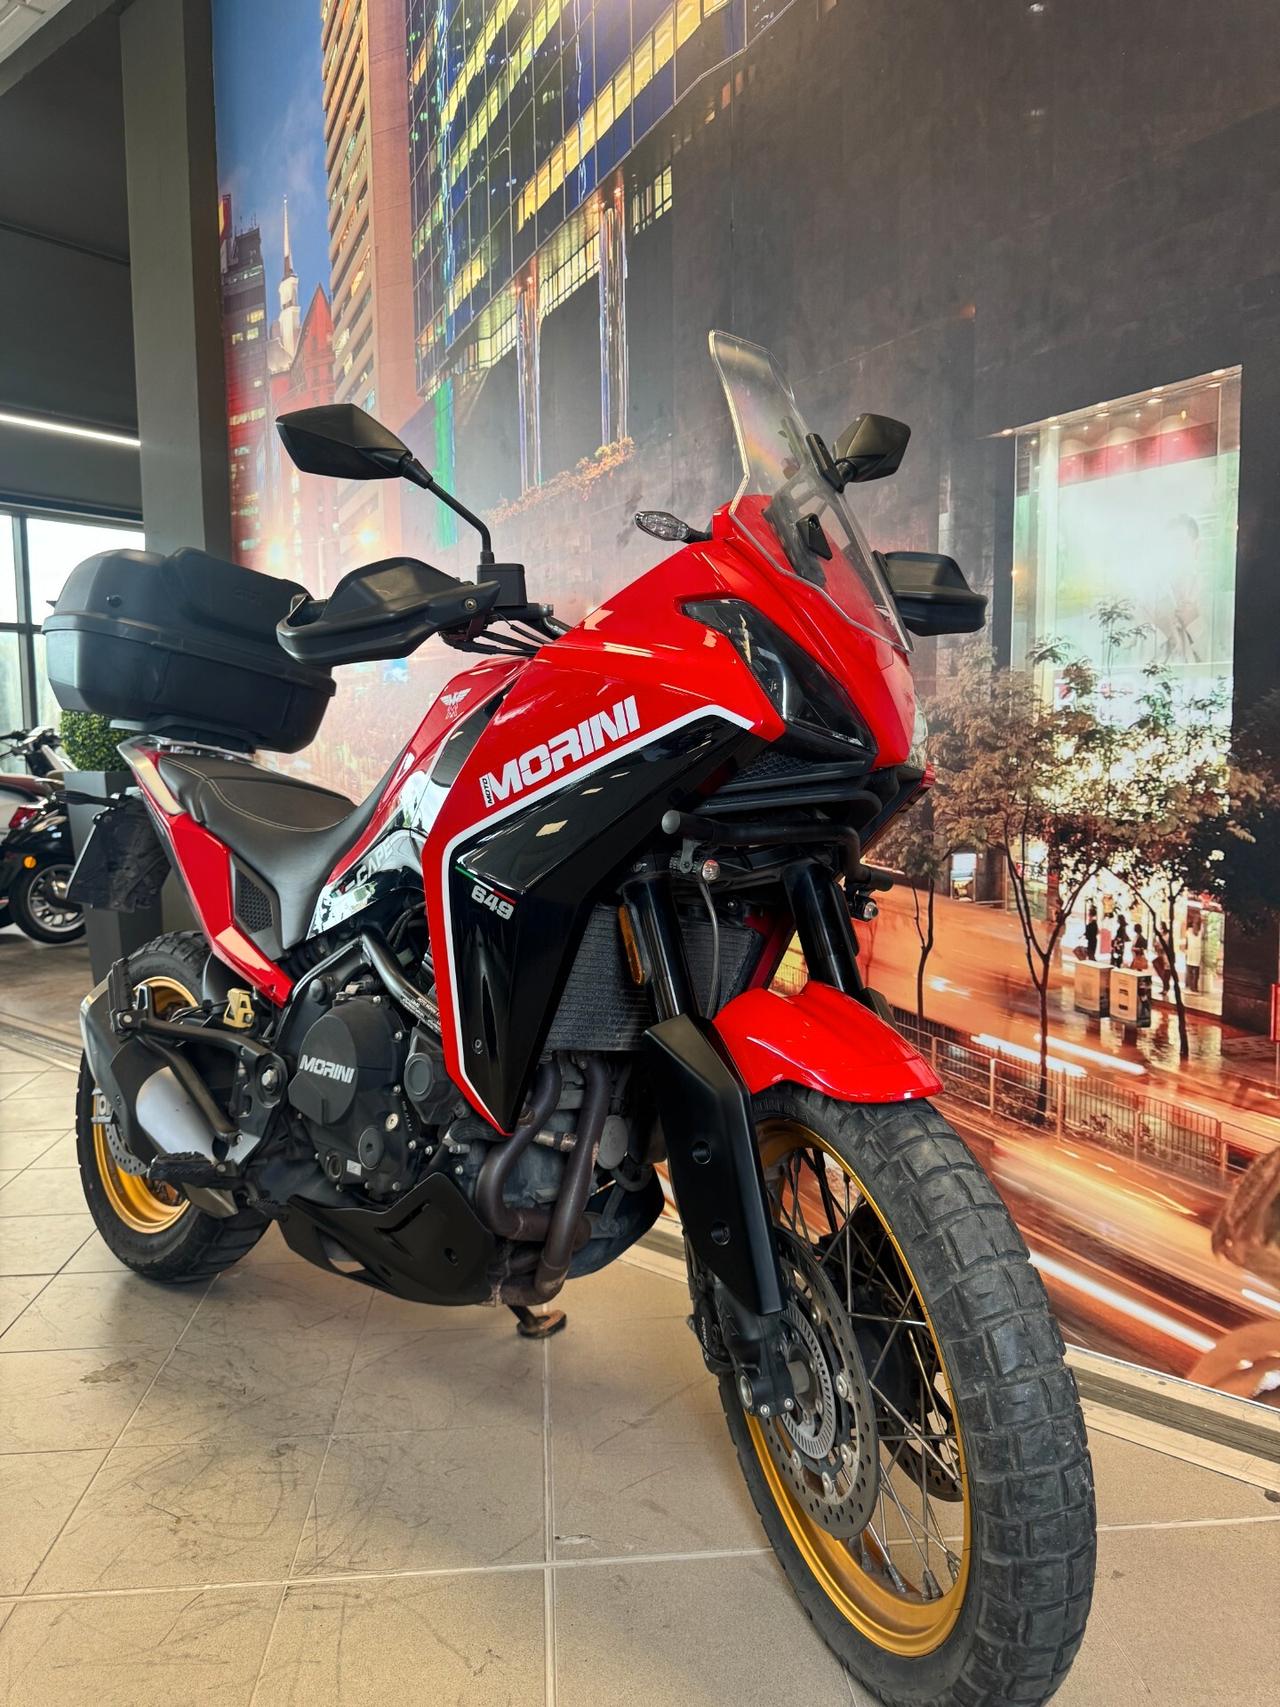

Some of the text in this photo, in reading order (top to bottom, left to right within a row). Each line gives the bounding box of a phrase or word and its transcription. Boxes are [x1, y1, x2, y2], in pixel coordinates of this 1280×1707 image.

[481, 695, 641, 805] MOTO MORINI
[471, 885, 515, 920] 649
[299, 1054, 355, 1084] MORINI
